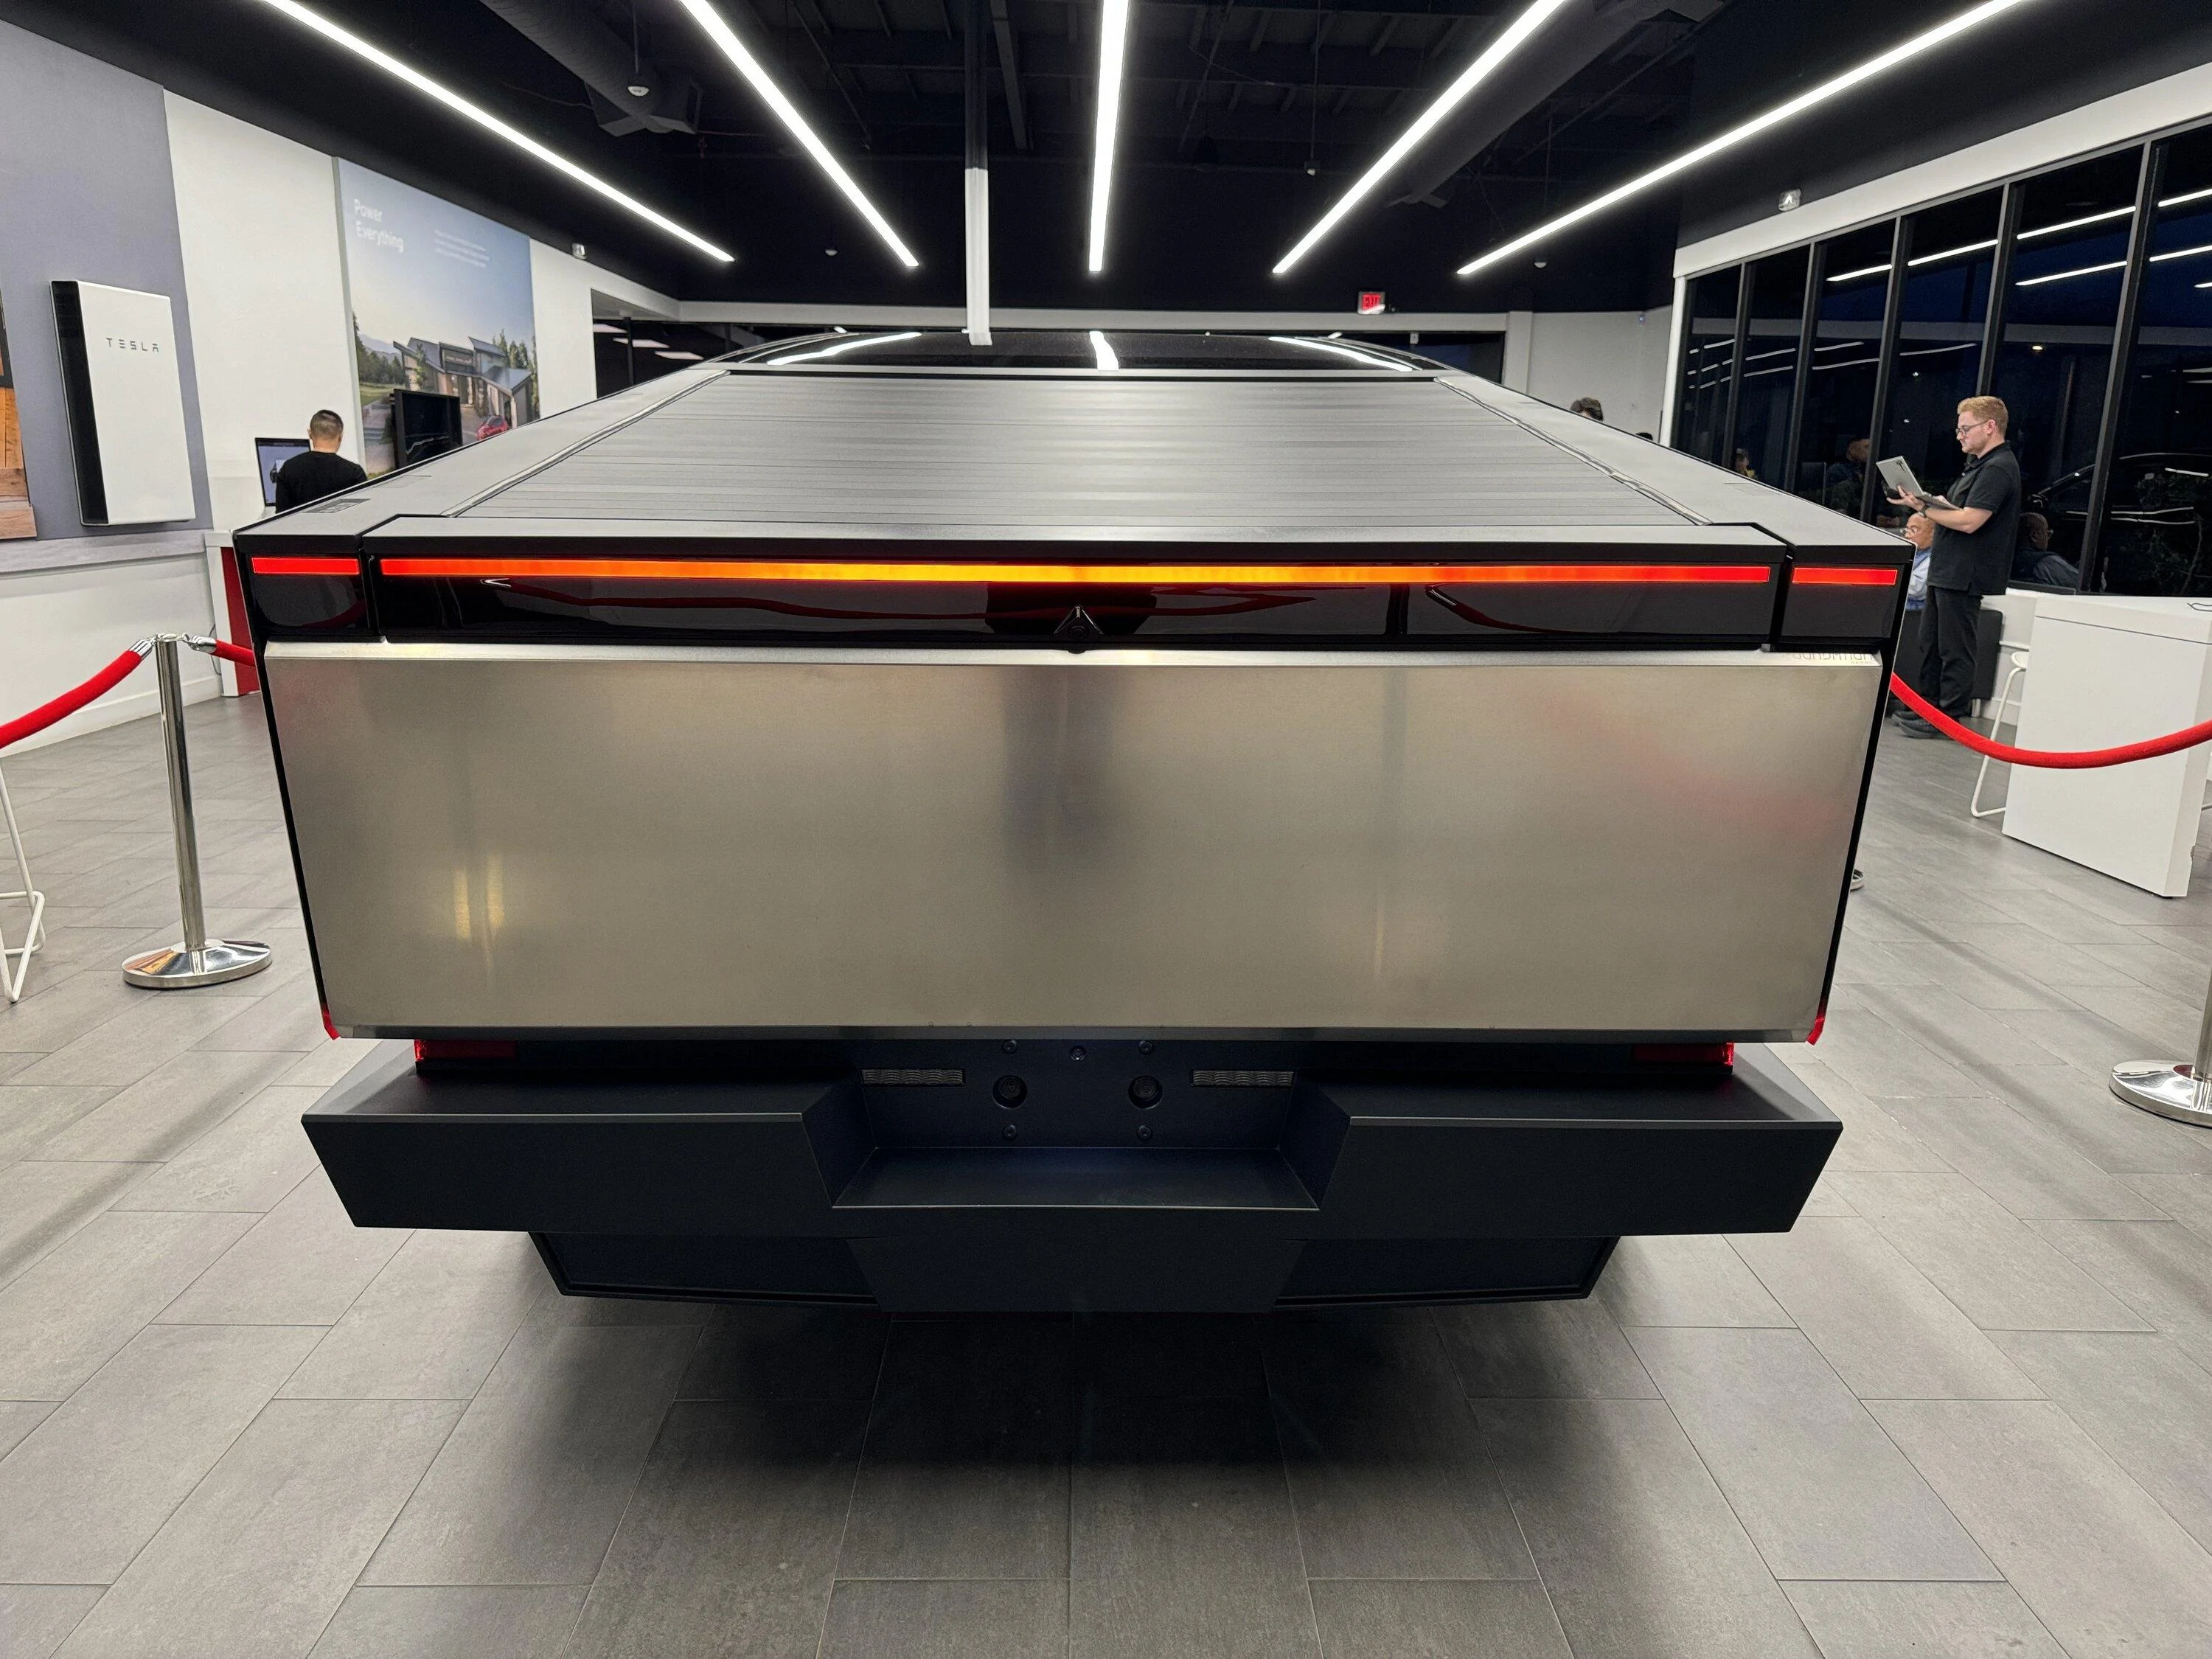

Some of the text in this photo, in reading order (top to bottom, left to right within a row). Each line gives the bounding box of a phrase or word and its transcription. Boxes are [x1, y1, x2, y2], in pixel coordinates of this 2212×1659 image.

[354, 198, 383, 222] Power
[356, 220, 404, 253] Everything
[105, 337, 159, 352] TESLA
